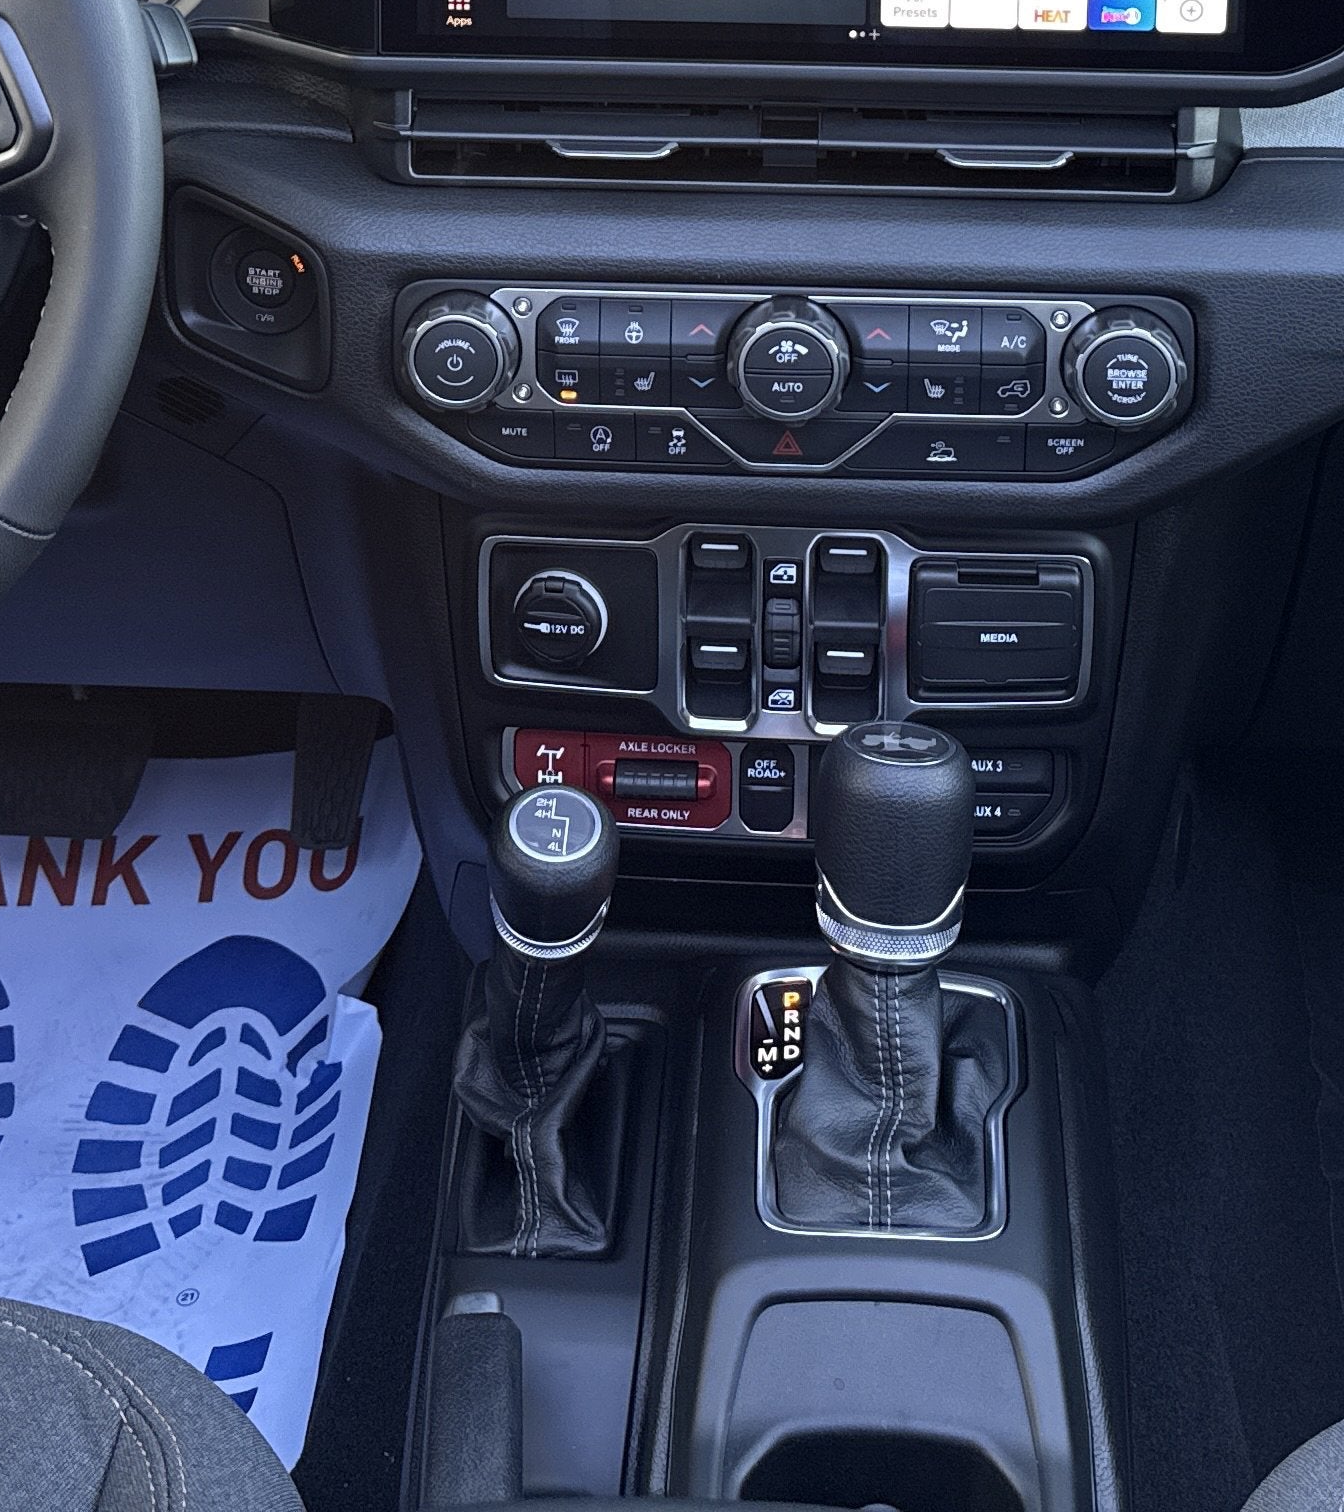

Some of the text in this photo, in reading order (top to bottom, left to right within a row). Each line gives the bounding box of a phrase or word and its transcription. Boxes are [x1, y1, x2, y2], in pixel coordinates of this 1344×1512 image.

[893, 6, 938, 19] Presets
[1034, 9, 1072, 24] HEAT
[445, 15, 473, 29] Apps
[247, 267, 281, 278] START
[246, 275, 284, 288] ENGINE
[252, 287, 280, 296] STOP
[437, 338, 471, 350] VOLUME
[554, 336, 580, 345] FRONT
[1000, 335, 1028, 349] A/C
[937, 344, 961, 353] MODE
[776, 352, 798, 364] OFF
[1117, 353, 1139, 363] TUNE
[1107, 368, 1148, 379] BROWSE
[772, 382, 804, 393] AUTO
[1112, 380, 1144, 390] ENTER
[1112, 392, 1143, 405] SCROLL
[501, 426, 528, 437] MUTE
[592, 443, 610, 452] OFF
[1047, 438, 1085, 447] SCREEN
[668, 445, 686, 455] OFF
[1055, 446, 1075, 455] OFF
[551, 624, 585, 635] 12V DC
[980, 633, 1018, 644] MEDIA
[619, 741, 696, 755] AXLE LOCKER
[754, 759, 777, 770] OFF
[971, 759, 1003, 772] AUX 3
[747, 767, 786, 779] ROAD+
[536, 797, 553, 807] 2H
[534, 809, 553, 819] 4H
[627, 807, 691, 820] REAR ONLY
[974, 806, 1002, 818] UX 4
[552, 828, 562, 838] N
[547, 842, 562, 852] 4L
[187, 816, 364, 903] YOU
[784, 991, 800, 1007] P
[784, 1009, 800, 1024] R
[784, 1026, 801, 1041] N
[757, 1046, 778, 1062] M
[783, 1044, 800, 1060] D
